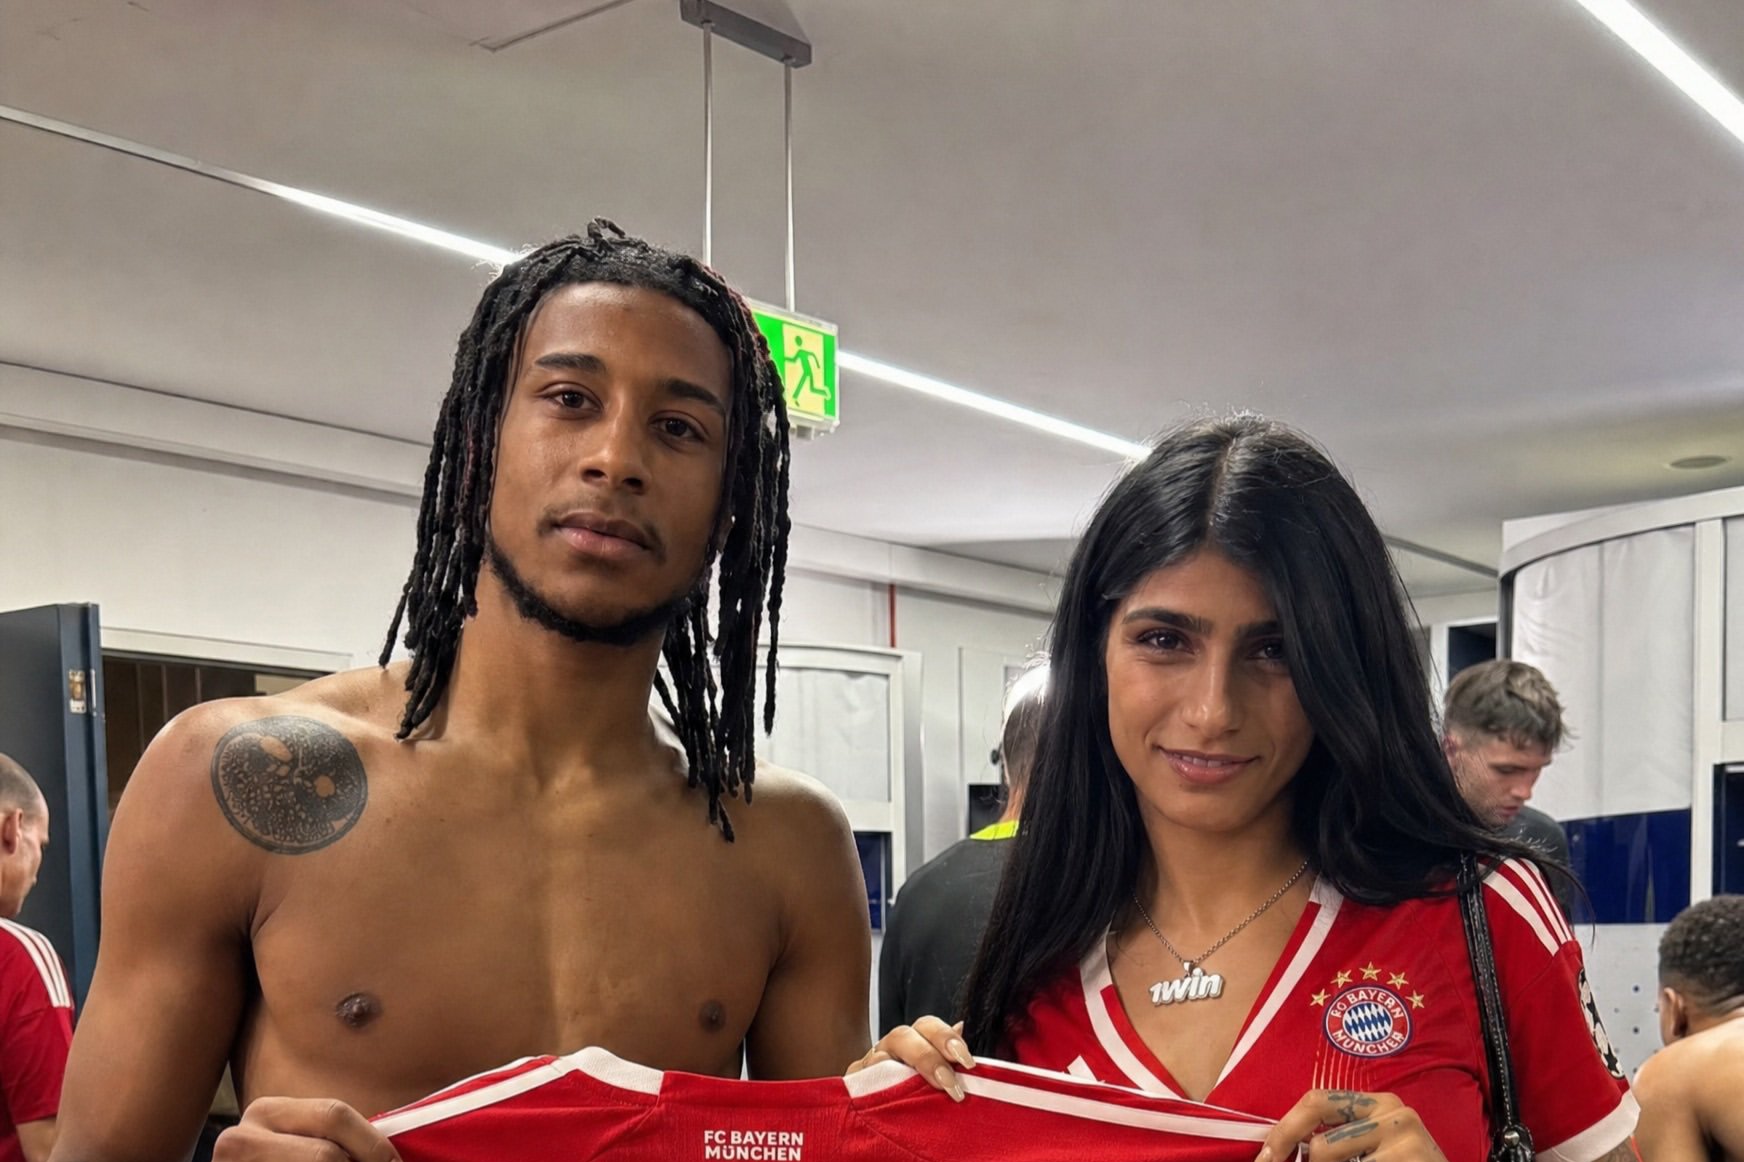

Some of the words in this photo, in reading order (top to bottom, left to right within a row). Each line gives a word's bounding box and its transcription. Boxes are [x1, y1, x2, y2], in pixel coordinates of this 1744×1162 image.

[1150, 967, 1223, 1005] 1win
[1347, 989, 1405, 1019] BAYERN
[704, 1130, 726, 1145] FC
[730, 1130, 804, 1146] BAYERN
[705, 1145, 801, 1162] MÜNCHEN
